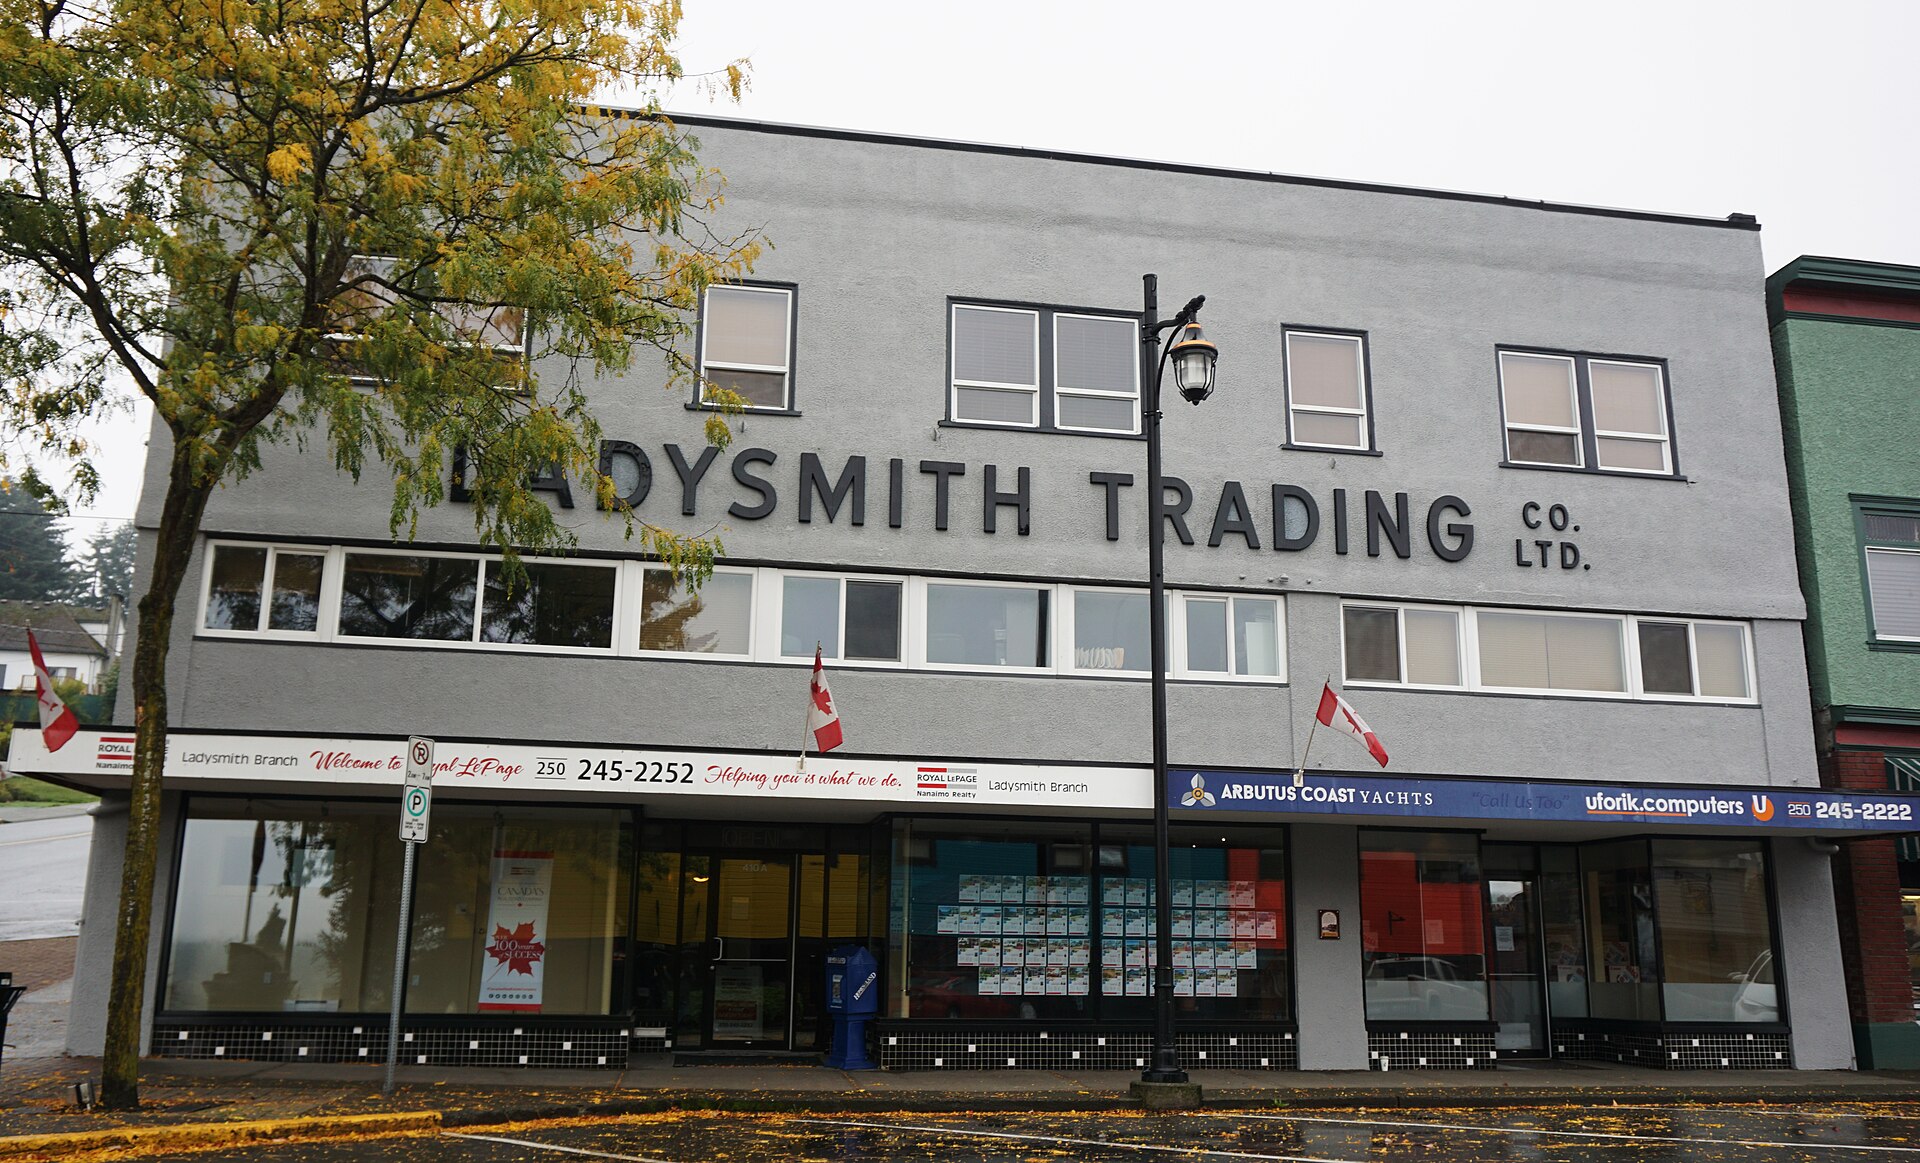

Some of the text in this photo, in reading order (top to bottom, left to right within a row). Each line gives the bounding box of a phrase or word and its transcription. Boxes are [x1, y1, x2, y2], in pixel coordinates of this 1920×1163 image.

[450, 438, 1474, 562] LADYSMITH TRADING
[1522, 501, 1580, 532] CO.
[1516, 538, 1591, 570] LTD.
[98, 744, 131, 753] ROYAL
[182, 751, 249, 765] Ladysmith
[254, 754, 298, 767] Branch
[310, 750, 523, 781] Welcome to yal LePage
[536, 759, 694, 784] 250 245-2252
[704, 765, 902, 790] Helping you is what we do.
[917, 774, 945, 782] ROYAL
[917, 790, 976, 799] Nanaimo Realty
[988, 780, 1088, 793] Ladysmith Branch
[1221, 783, 1433, 806] ARBUTUS COAST YACHTS
[413, 795, 421, 810] P
[1515, 795, 1532, 809] Us
[1585, 792, 1744, 817] uforik.computers
[1788, 801, 1913, 821] 250 245-2222
[743, 863, 768, 872] 410 A
[495, 939, 518, 951] 100
